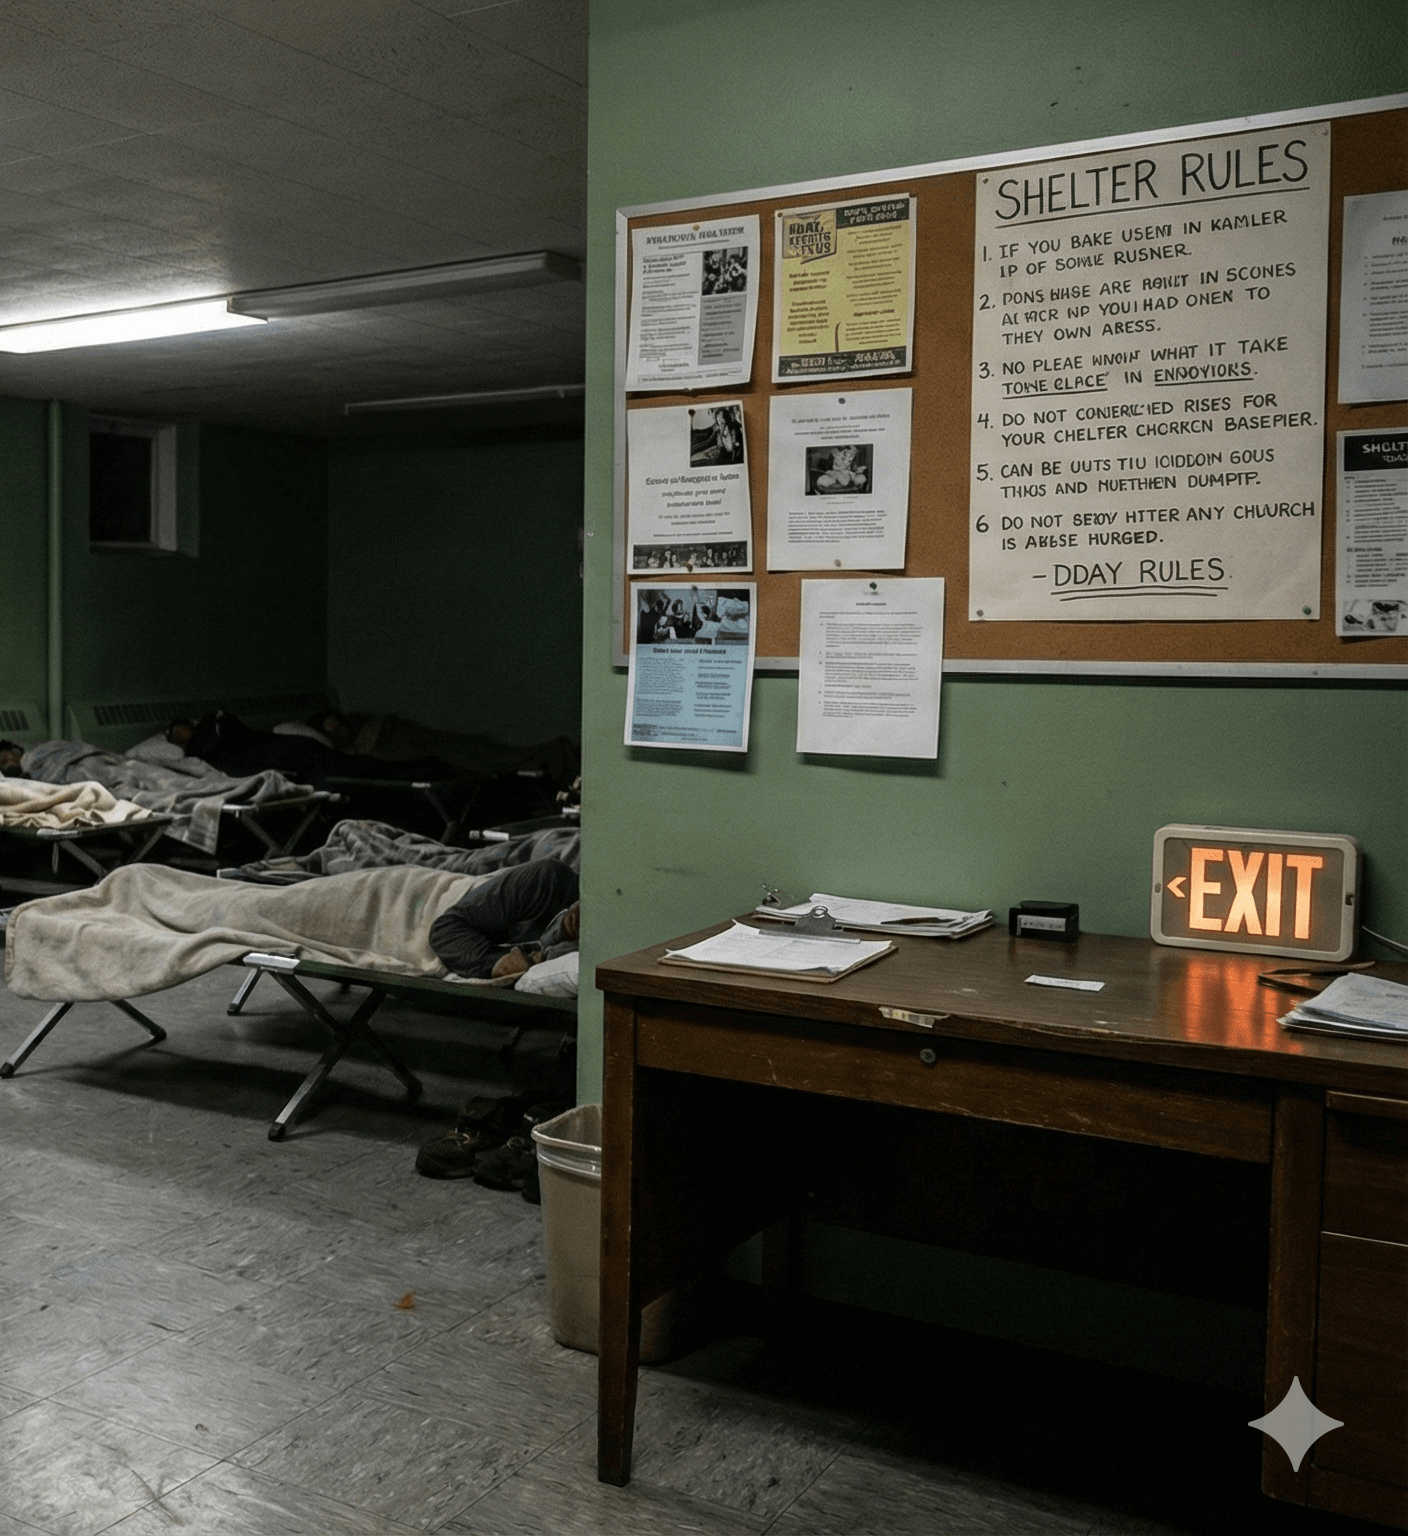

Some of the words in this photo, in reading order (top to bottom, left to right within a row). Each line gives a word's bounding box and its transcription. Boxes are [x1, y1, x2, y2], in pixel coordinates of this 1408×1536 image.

[994, 158, 1159, 221] SHELTER
[1181, 139, 1309, 196] RULES
[983, 246, 992, 262] 1.
[999, 243, 1019, 259] IF
[1028, 239, 1061, 254] YOU
[1071, 231, 1113, 249] BAKE
[1183, 221, 1201, 235] IN
[1211, 209, 1288, 231] KAMLER
[1026, 261, 1047, 275] OF
[1114, 243, 1192, 265] RUSNER.
[979, 294, 996, 311] 2.
[1099, 279, 1132, 296] ARE
[1200, 270, 1219, 284] IN
[1226, 262, 1296, 282] SCONES
[1143, 296, 1179, 311] HAD
[1245, 287, 1271, 300] TO
[1002, 330, 1044, 345] THEY
[1053, 326, 1091, 341] OWN
[978, 361, 995, 379] 3.
[1002, 361, 1025, 375] NO
[1032, 356, 1083, 372] PLEAE
[1150, 344, 1199, 361] WHAT
[1209, 342, 1227, 357] IT
[1238, 336, 1289, 354] TAKE
[1124, 370, 1142, 384] IN
[977, 413, 994, 429] 4.
[1002, 413, 1025, 427] DO
[1033, 409, 1067, 424] NOT
[1184, 396, 1231, 413] RISES
[1243, 393, 1278, 408] FOR
[1001, 431, 1046, 447] YOUR
[1225, 411, 1318, 431] BASEPIER.
[976, 463, 994, 481] 5.
[1000, 463, 1033, 478] CAN
[1041, 461, 1062, 476] BE
[1055, 481, 1088, 494] AND
[976, 514, 989, 533] 6
[1001, 516, 1023, 531] DO
[1031, 514, 1063, 528] NOT
[1125, 508, 1180, 523] HITER
[1186, 506, 1225, 522] ANY
[1002, 538, 1017, 551] IS
[1088, 530, 1164, 546] HURGED.
[1189, 847, 1324, 940] EXIT
